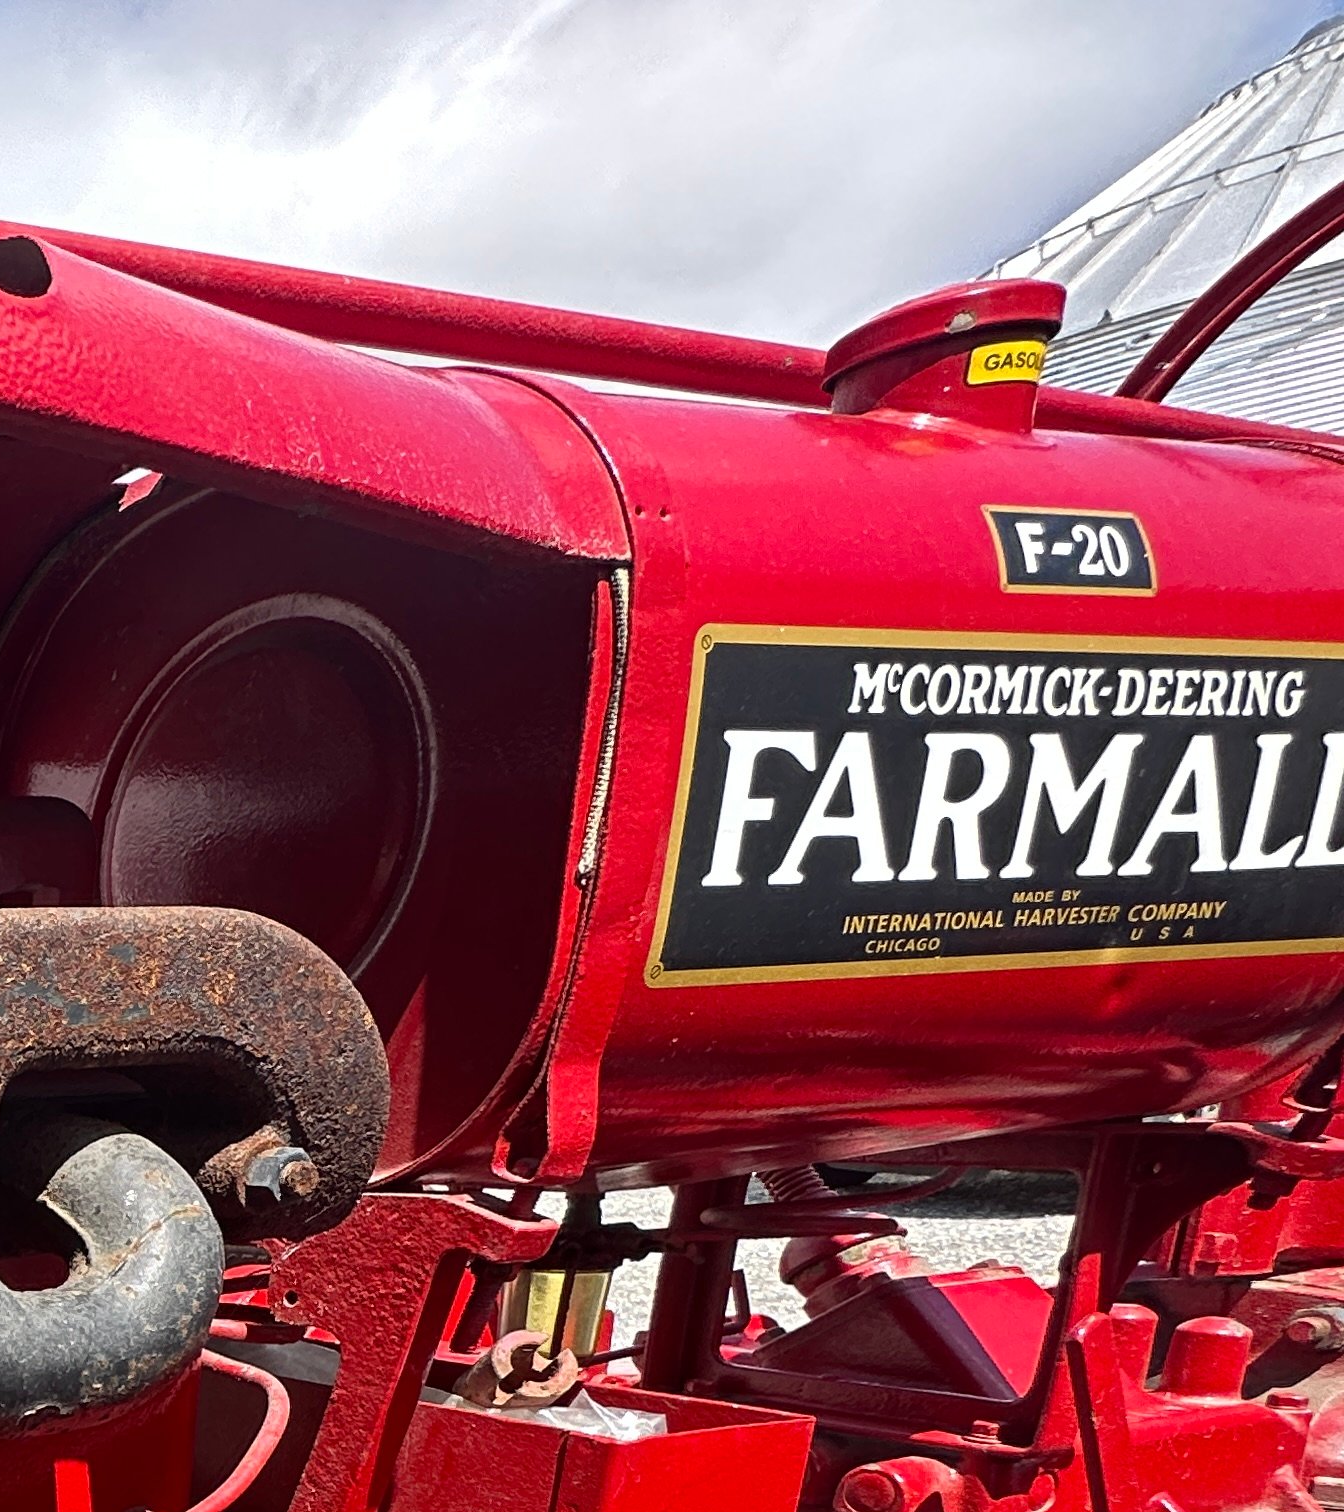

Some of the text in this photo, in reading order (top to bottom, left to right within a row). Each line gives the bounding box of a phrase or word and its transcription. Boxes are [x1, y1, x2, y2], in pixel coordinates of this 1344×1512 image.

[1015, 522, 1129, 577] F-20
[1012, 889, 1081, 904] MADE BY
[842, 900, 1227, 935] INTERNATIONAL HARVESTER COMPANY
[1130, 925, 1195, 941] U S A
[865, 937, 941, 954] CHICAGO
